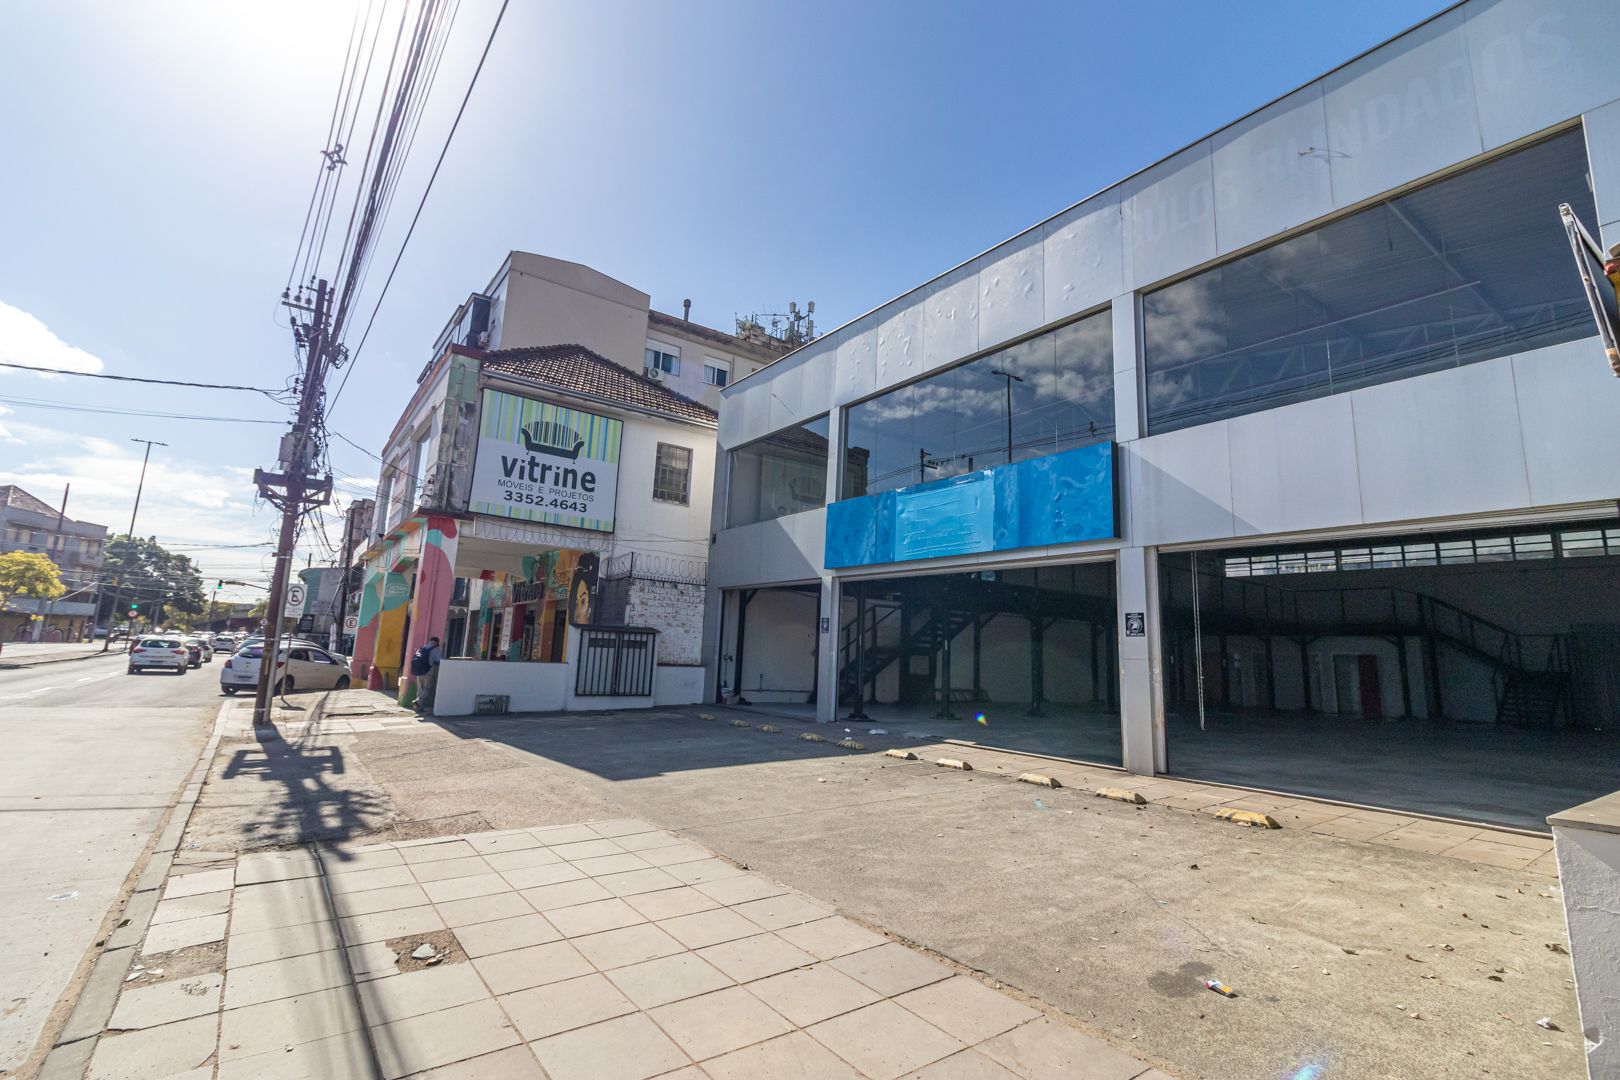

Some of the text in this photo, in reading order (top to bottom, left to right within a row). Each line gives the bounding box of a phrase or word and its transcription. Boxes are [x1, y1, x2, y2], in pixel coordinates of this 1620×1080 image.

[503, 490, 587, 513] 3352.4643
[538, 486, 545, 494] E
[548, 488, 594, 502] PROJETOS
